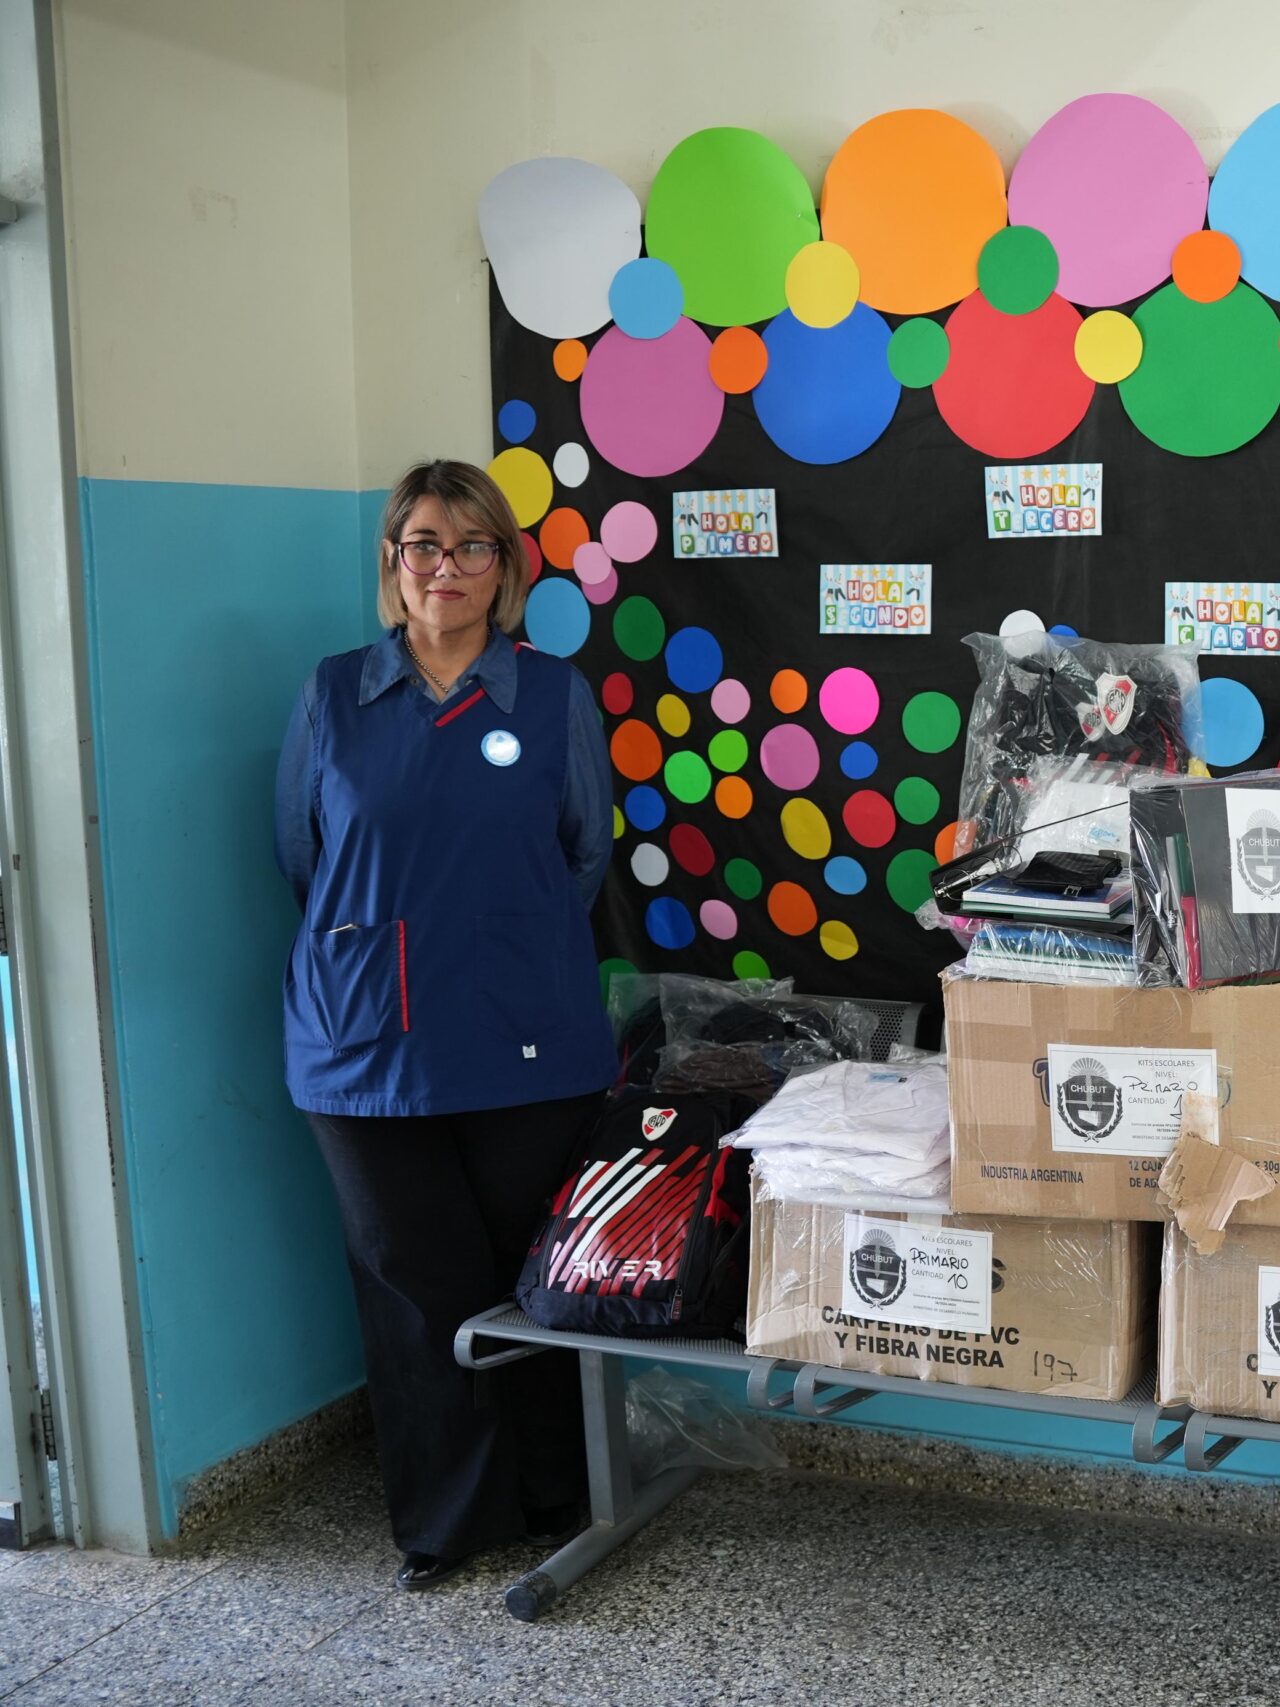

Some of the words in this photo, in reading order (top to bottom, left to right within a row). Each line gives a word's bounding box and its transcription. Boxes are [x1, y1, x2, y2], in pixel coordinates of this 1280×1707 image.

[1021, 485, 1080, 507] HOLA
[702, 512, 753, 532] HOLA
[681, 534, 772, 555] PIMERO
[847, 580, 902, 602] HOLA
[826, 605, 925, 627] SGUNDO
[1198, 600, 1262, 624] HOLA
[1248, 838, 1280, 847] CHUBUT
[1070, 1084, 1107, 1095] CHUBUT
[1128, 1097, 1167, 1105] CANTIDAD:
[981, 1165, 1029, 1181] INDUSTRIA
[1030, 1168, 1084, 1184] ARGENTINA
[1129, 1160, 1139, 1171] 12
[1263, 1161, 1280, 1174] 30g
[1129, 1177, 1141, 1188] DE
[936, 1237, 973, 1247] ESCOLARES
[860, 1253, 894, 1264] CHUBUT
[909, 1247, 969, 1270] PRIMARIO
[573, 1260, 661, 1279] RIVER
[948, 1274, 968, 1290] 10
[834, 1331, 848, 1349] Y
[855, 1334, 920, 1359] FIBRA
[926, 1344, 1004, 1368] NEGRA
[1262, 1380, 1277, 1399] Y
